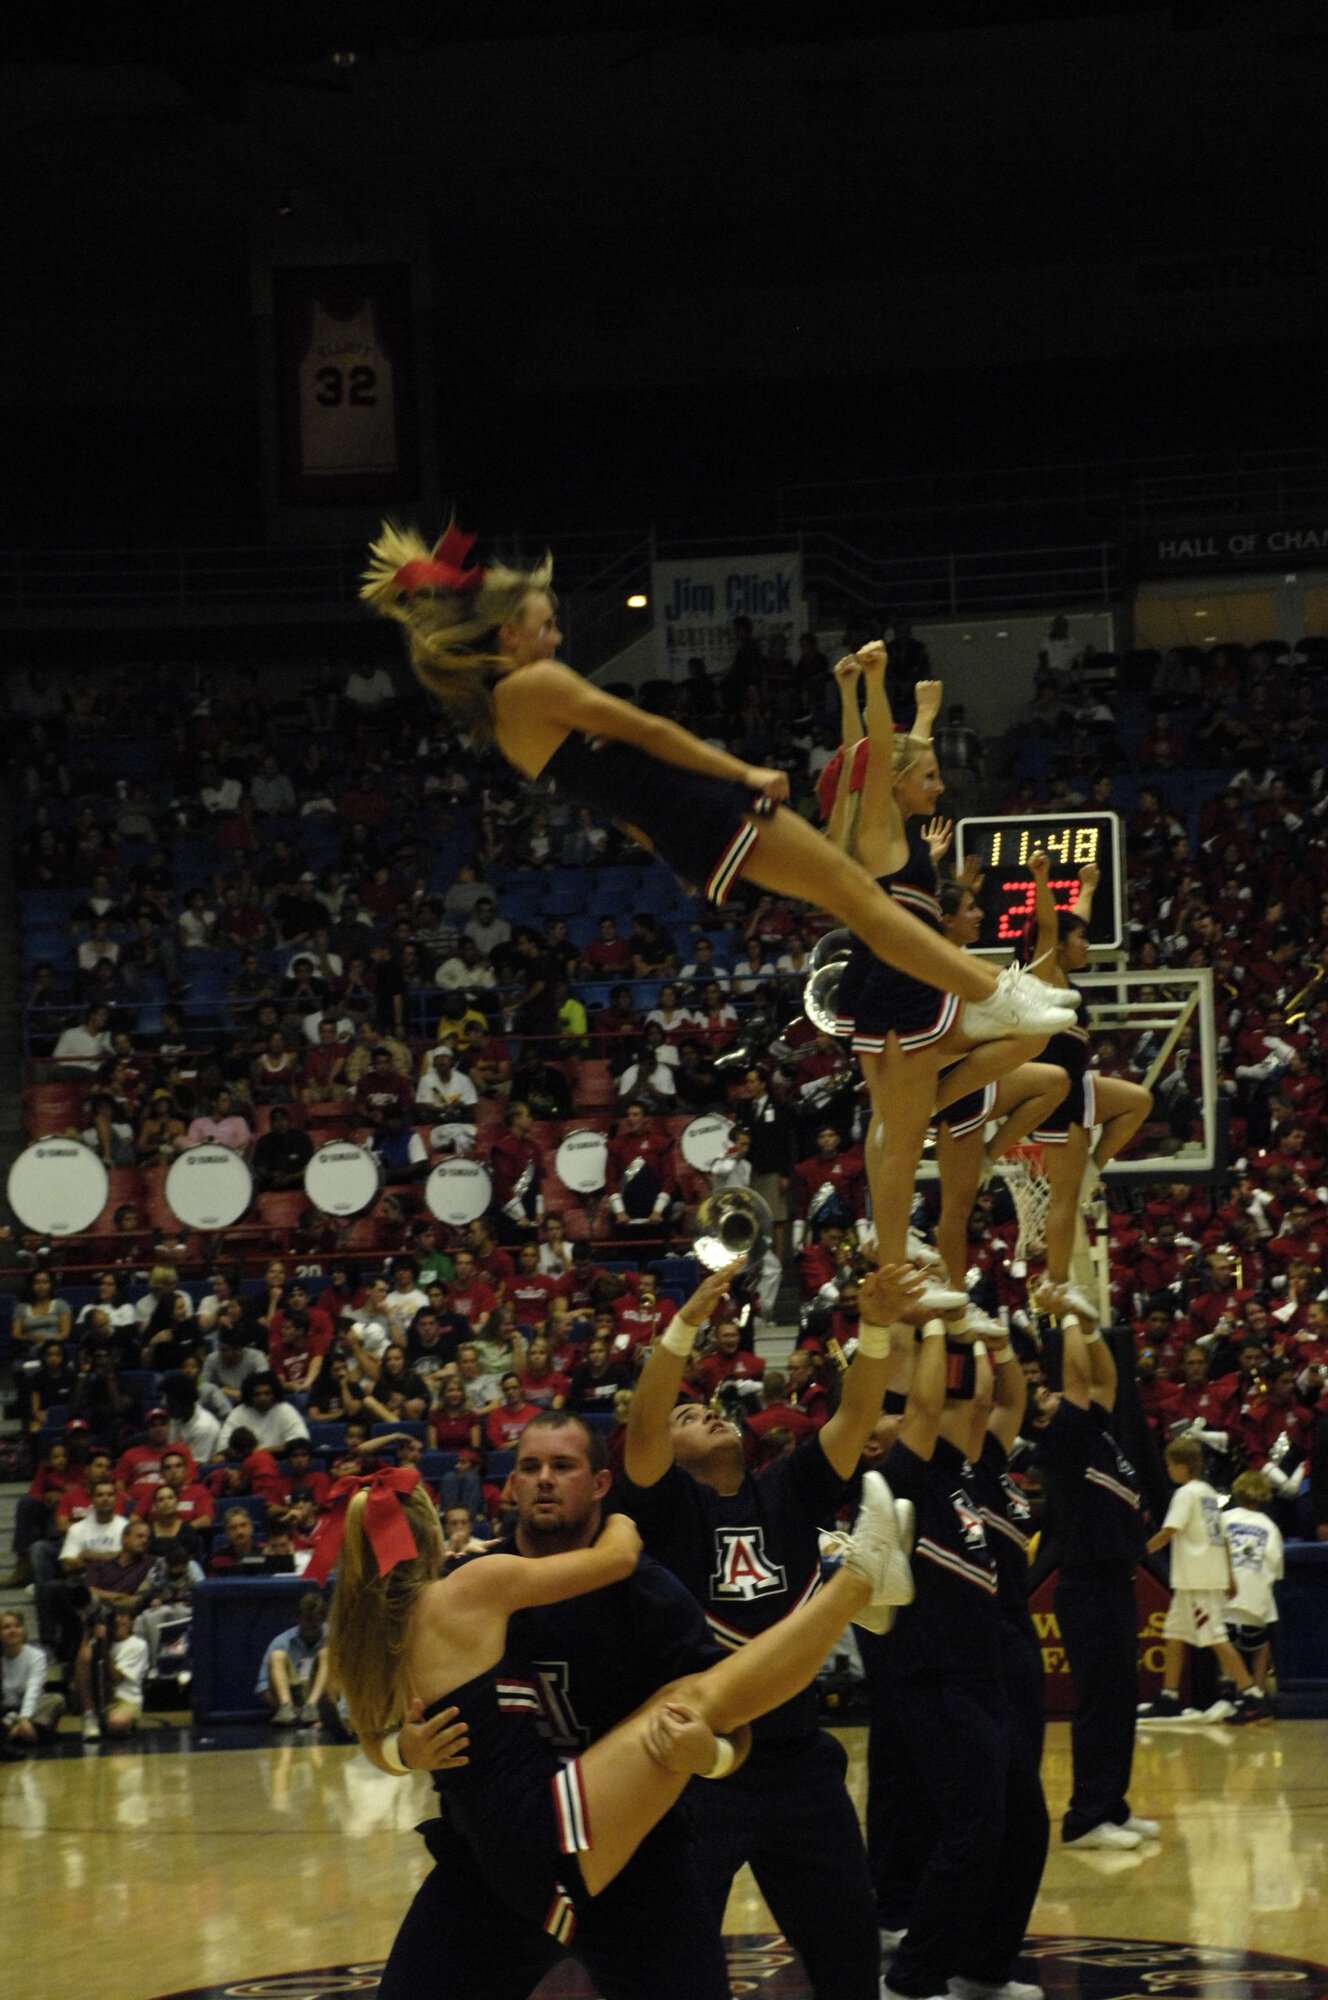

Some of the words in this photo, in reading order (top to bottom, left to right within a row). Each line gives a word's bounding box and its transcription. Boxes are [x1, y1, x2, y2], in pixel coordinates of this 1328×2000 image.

[316, 365, 376, 406] 32
[1158, 537, 1219, 560] HALL
[1266, 528, 1328, 553] CHA
[664, 576, 714, 621] Jim
[725, 572, 792, 616] Click
[990, 827, 1099, 866] 11:48
[709, 1526, 788, 1602] A
